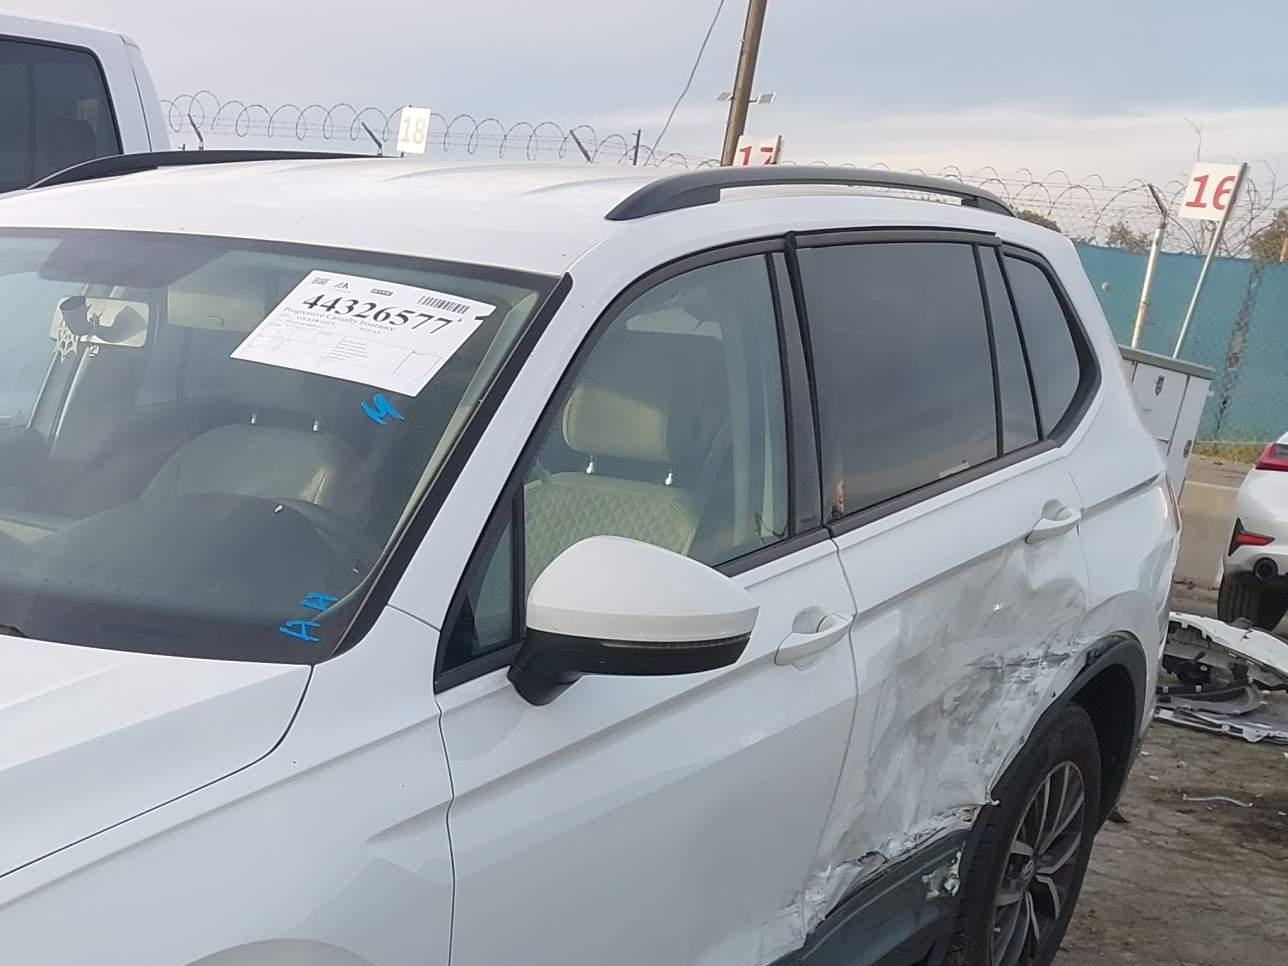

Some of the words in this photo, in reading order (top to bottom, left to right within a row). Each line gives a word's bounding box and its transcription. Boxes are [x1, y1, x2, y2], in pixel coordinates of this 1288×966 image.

[400, 117, 426, 144] 18
[1185, 175, 1237, 210] 16
[302, 294, 452, 335] 44326577
